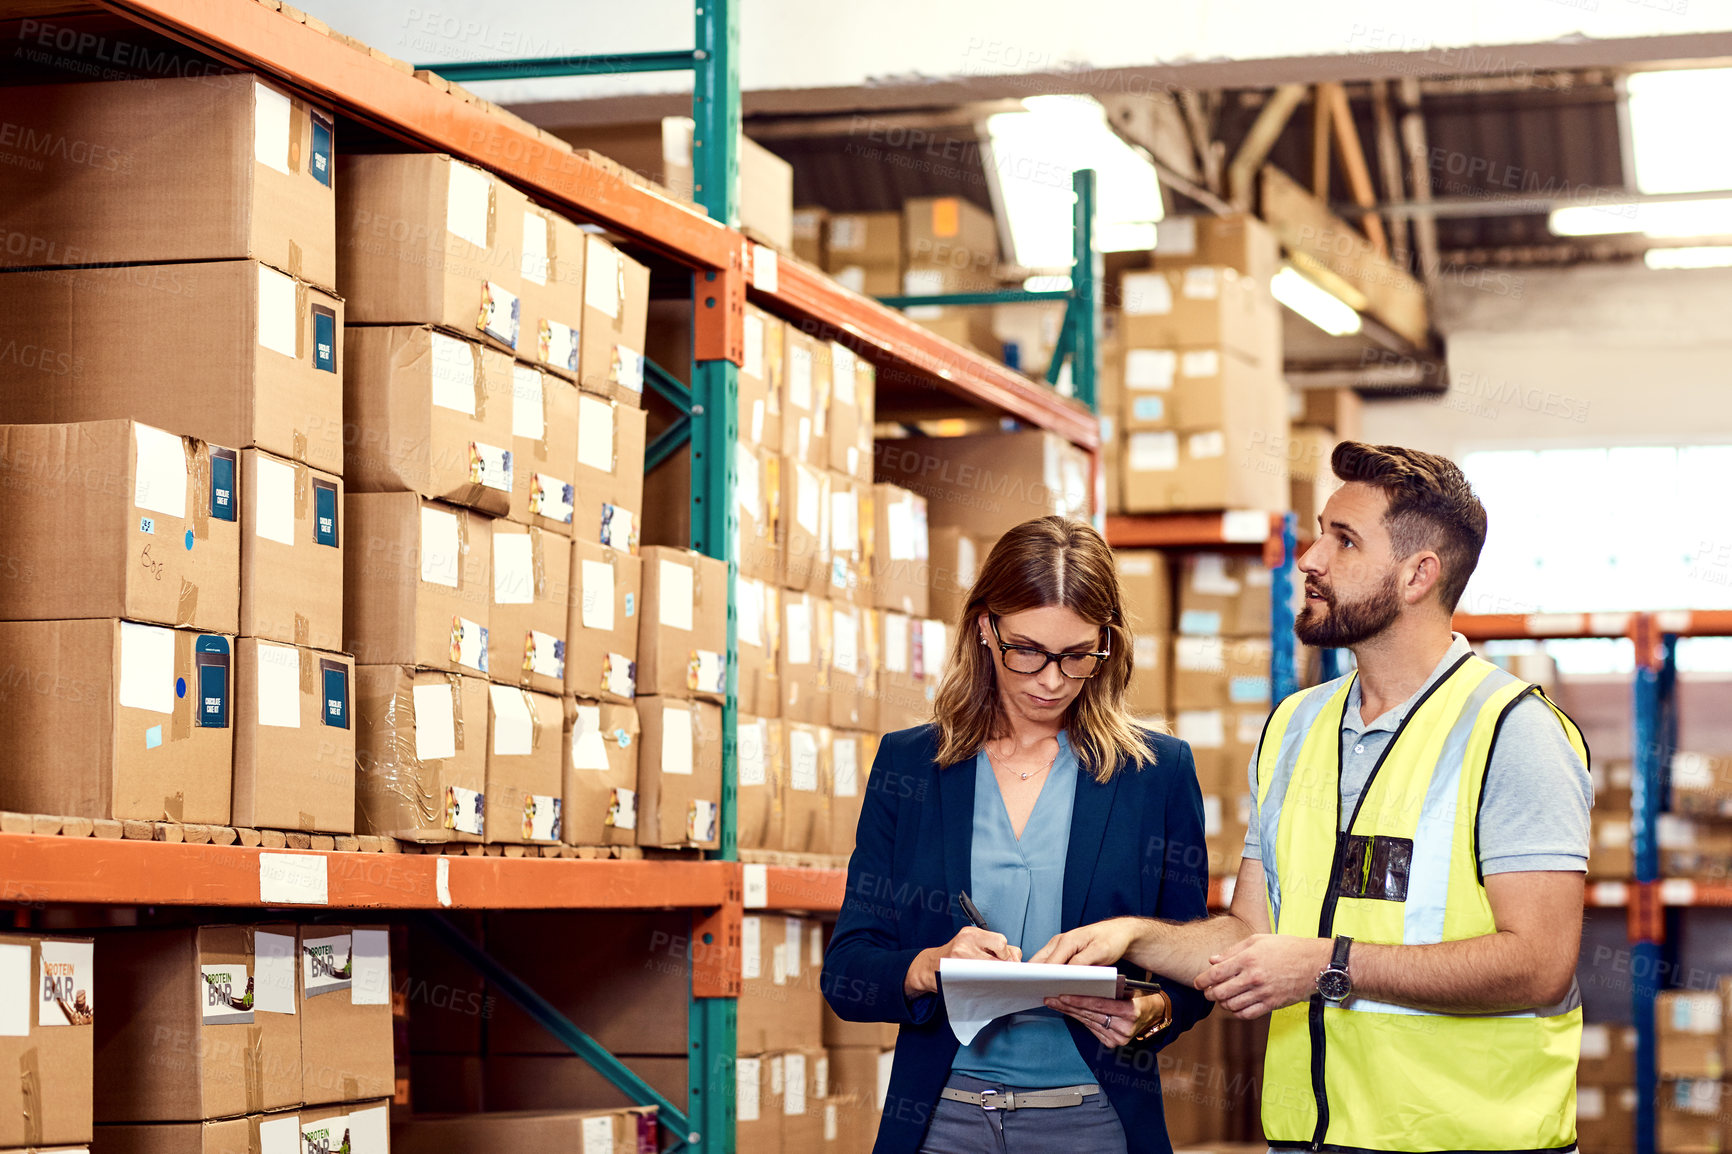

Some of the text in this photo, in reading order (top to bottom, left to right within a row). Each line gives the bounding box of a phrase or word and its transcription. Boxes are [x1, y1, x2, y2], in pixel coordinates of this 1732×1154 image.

[311, 944, 334, 956] PROTEIN
[44, 961, 75, 976] PROTEIN
[311, 954, 335, 978] BAR
[207, 973, 232, 984] PROTEIN
[43, 976, 74, 1002] BAR
[208, 983, 233, 1006] BAR
[307, 1128, 330, 1142] PROTEIN
[308, 1138, 330, 1154] BAR
